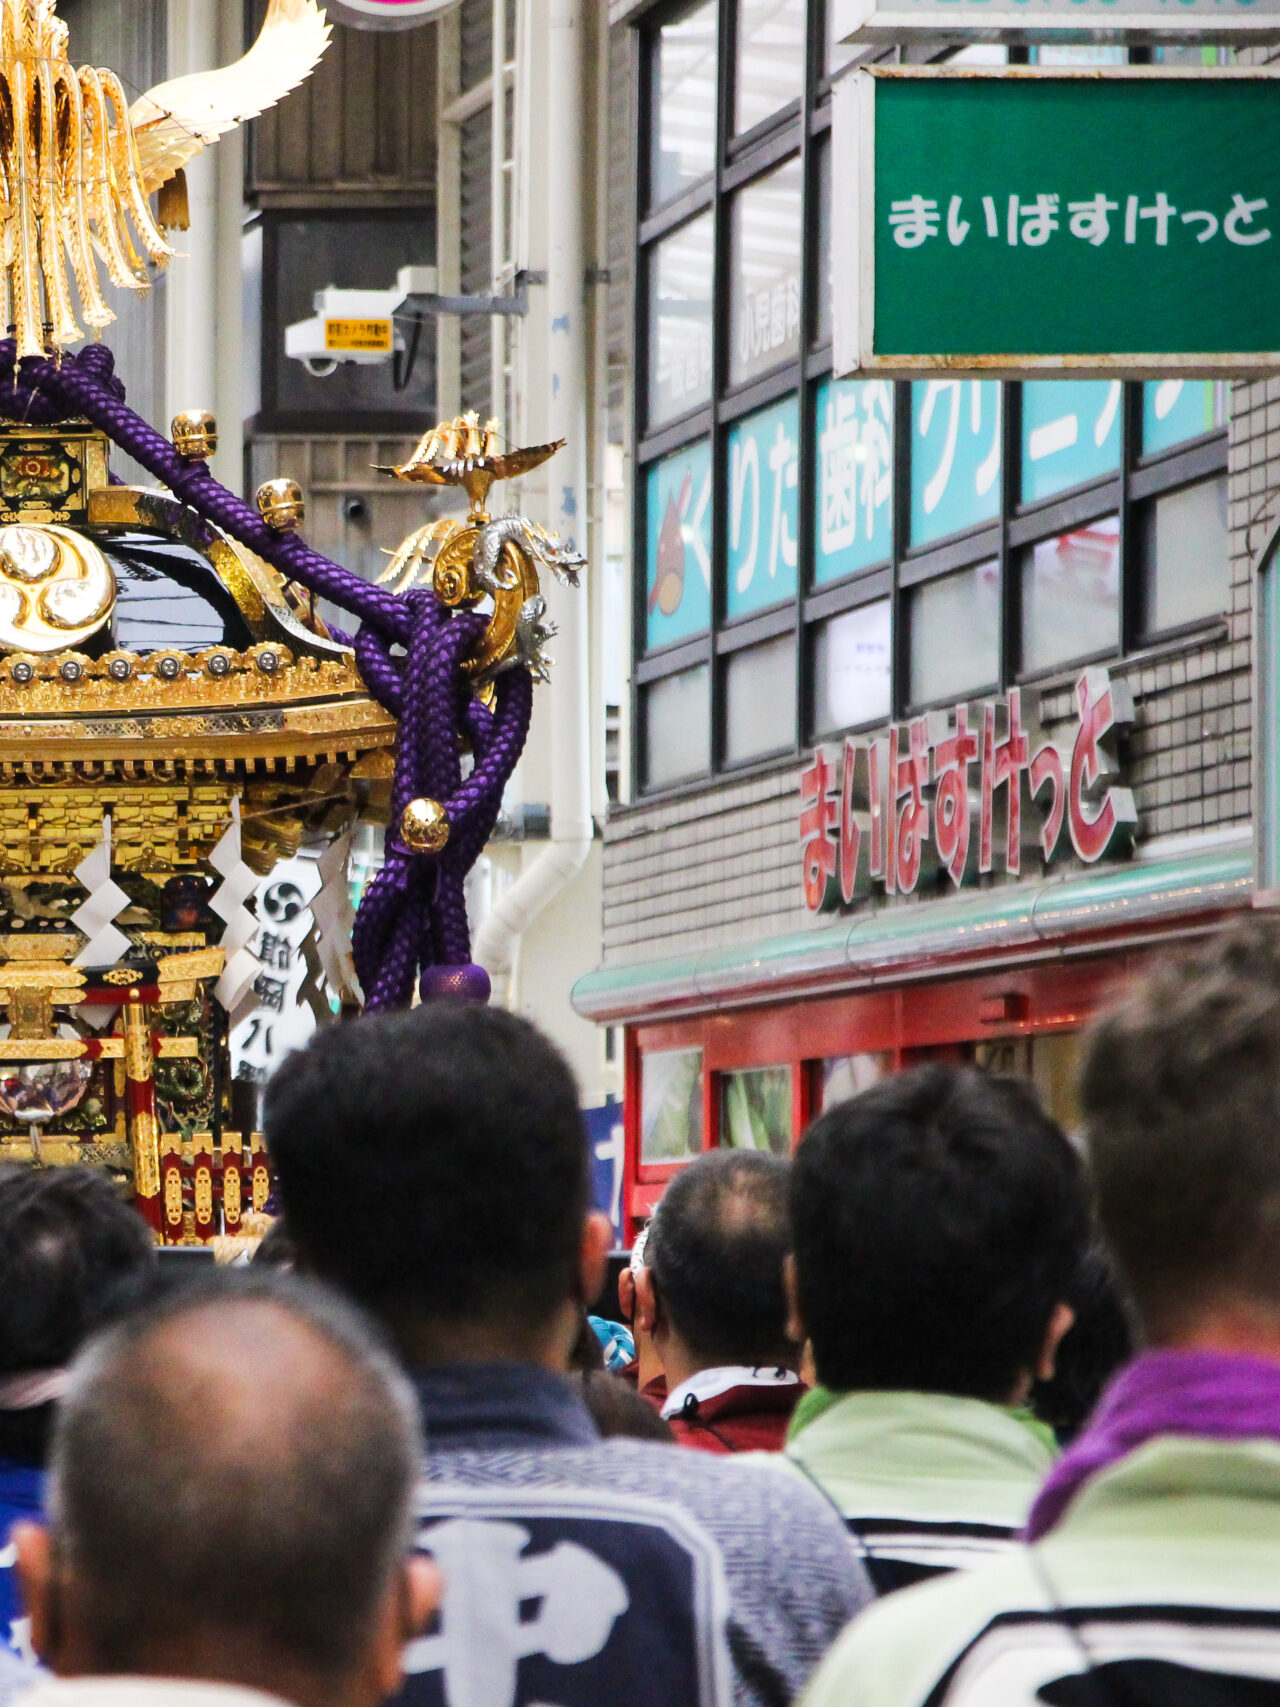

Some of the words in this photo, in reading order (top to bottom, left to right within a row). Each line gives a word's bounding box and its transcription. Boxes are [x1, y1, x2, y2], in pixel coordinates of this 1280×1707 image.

[887, 192, 1272, 249] まいばすけっと
[799, 667, 1116, 911] まいばすけっと
